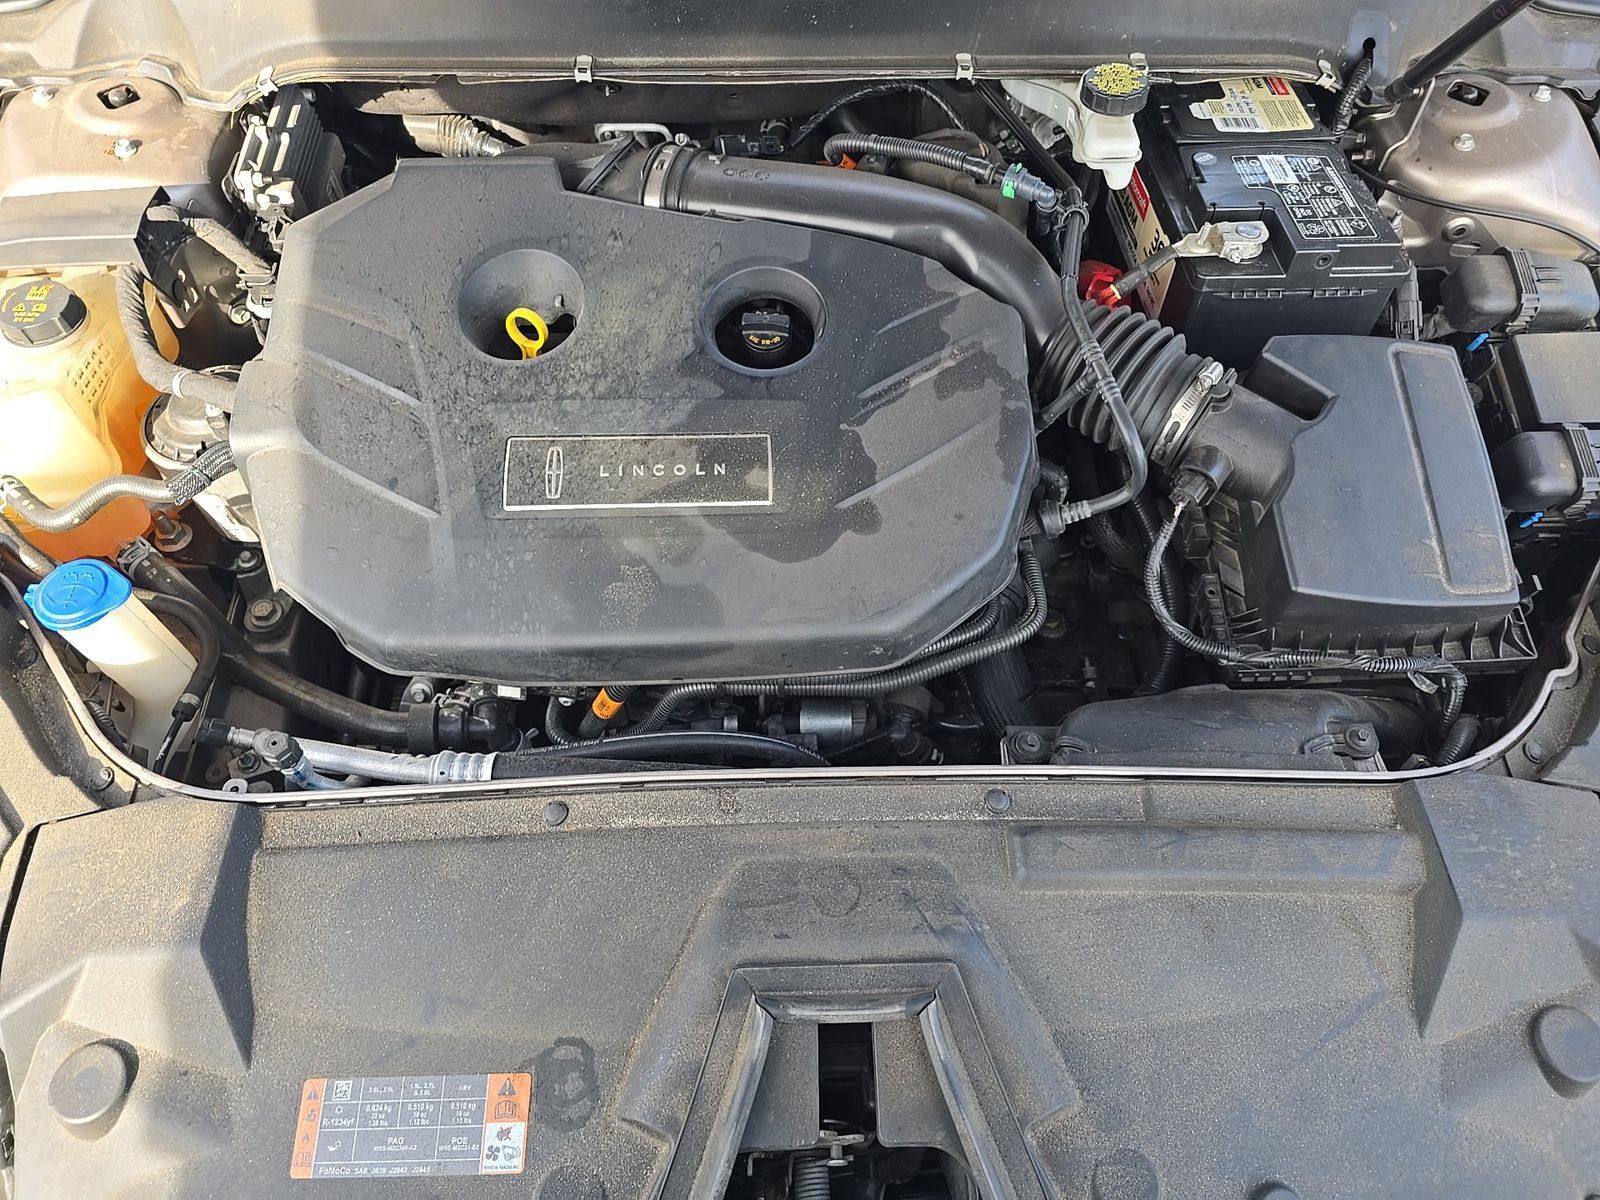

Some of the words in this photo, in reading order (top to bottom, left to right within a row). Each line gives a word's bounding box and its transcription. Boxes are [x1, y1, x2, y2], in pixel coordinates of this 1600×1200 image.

[1124, 195, 1138, 230] AGM
[599, 462, 727, 478] LINCOLN
[366, 1104, 382, 1112] 0.624
[384, 1104, 392, 1113] kg
[408, 1103, 424, 1111] 0.510
[426, 1103, 434, 1112] kg
[451, 1102, 467, 1110] 0.510
[468, 1102, 476, 1111] kg
[322, 1117, 355, 1127] R-1234yf
[387, 1137, 404, 1145] PAG
[451, 1136, 468, 1144] POE
[318, 1167, 350, 1175] FoMoCo
[354, 1167, 368, 1175] SAE
